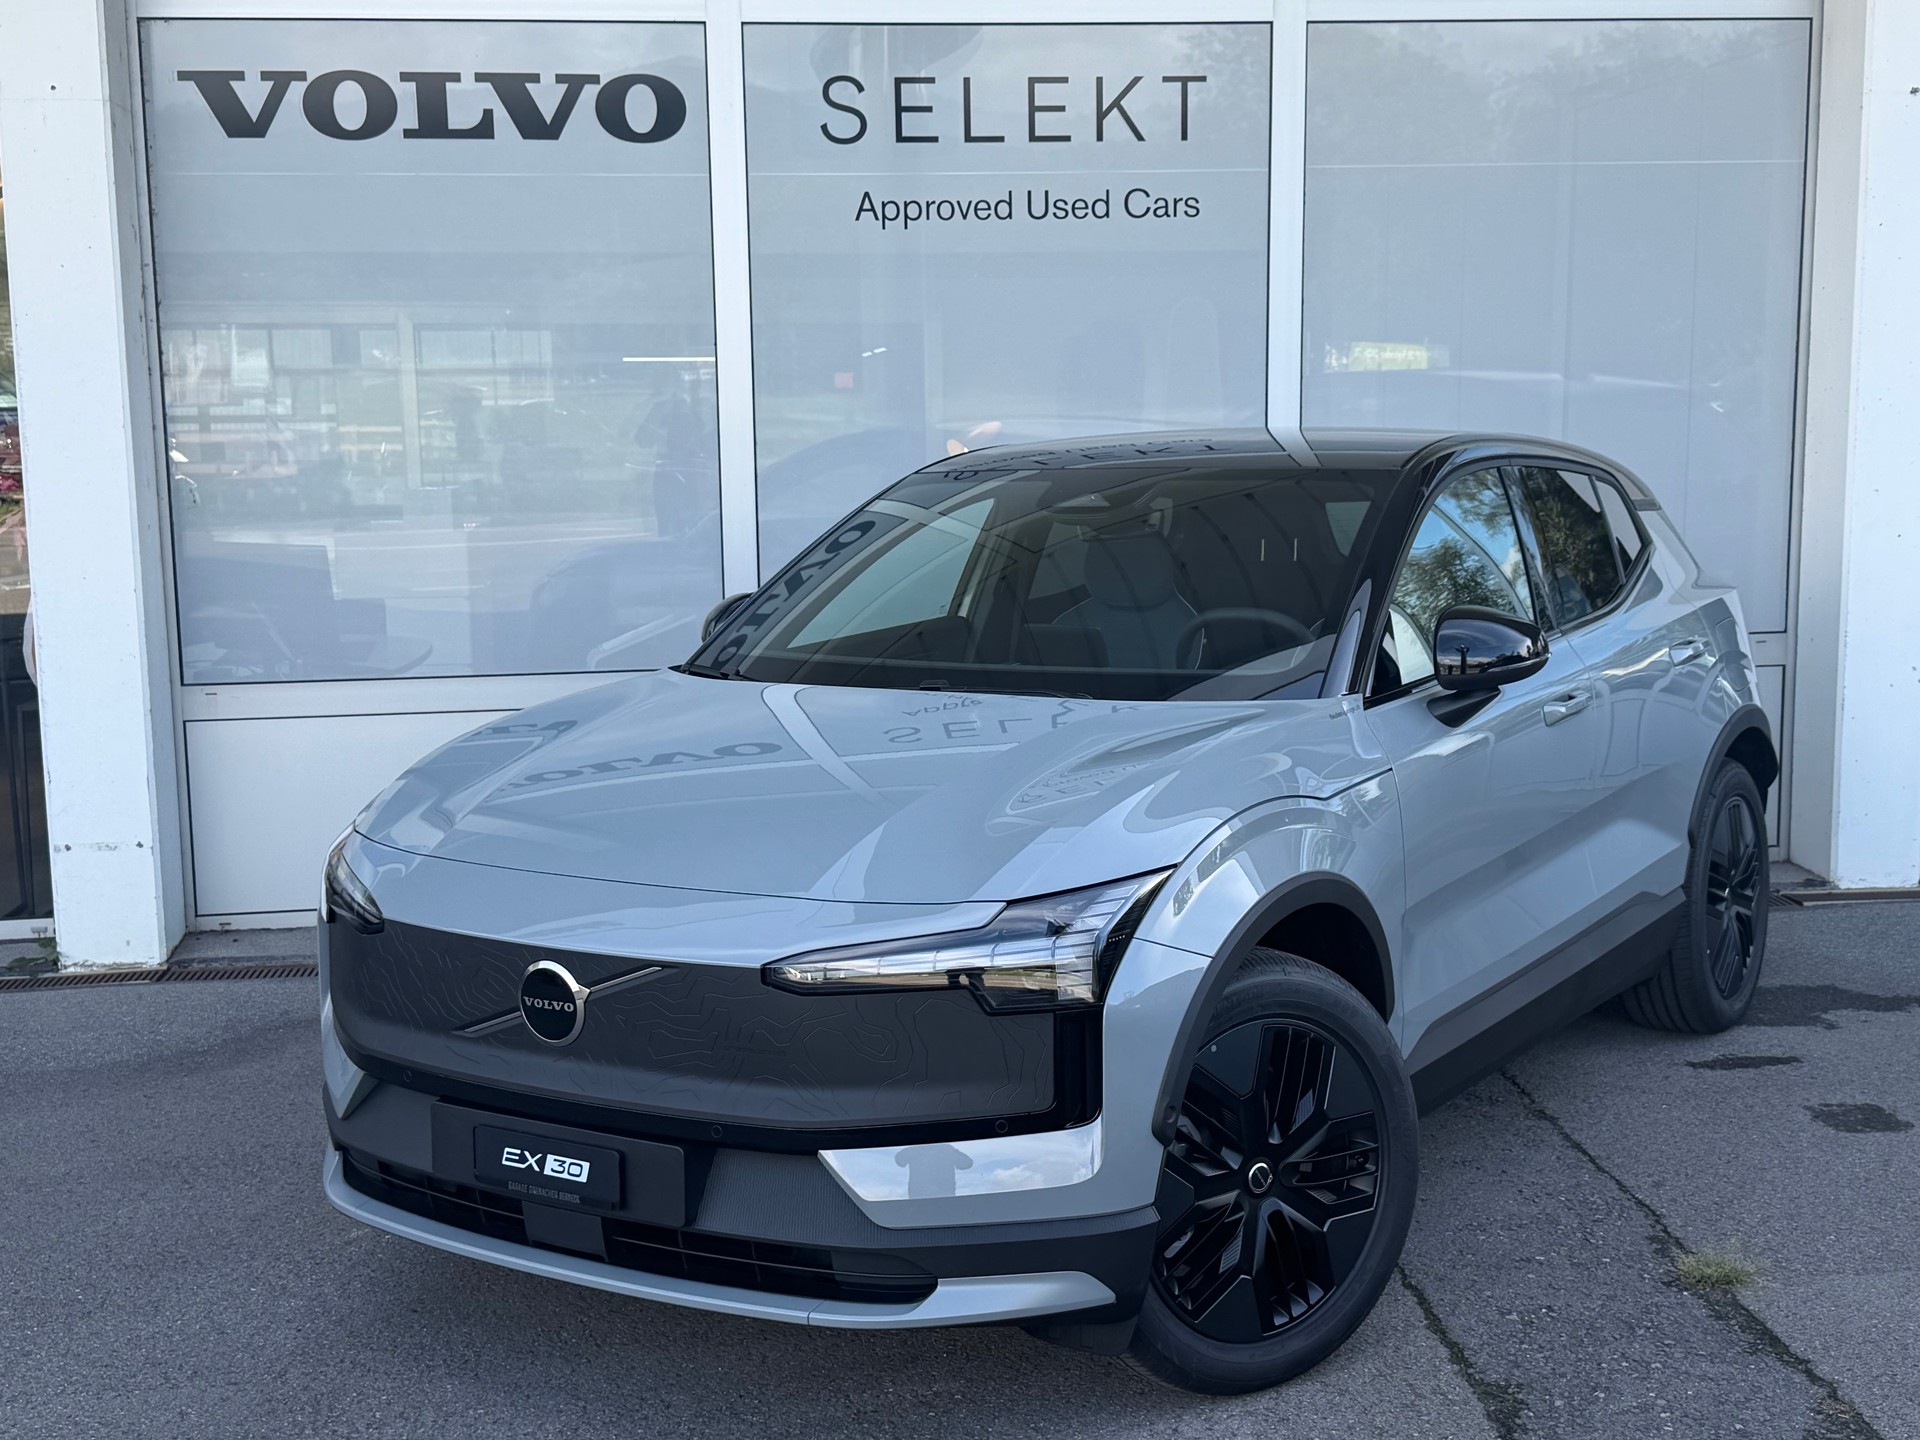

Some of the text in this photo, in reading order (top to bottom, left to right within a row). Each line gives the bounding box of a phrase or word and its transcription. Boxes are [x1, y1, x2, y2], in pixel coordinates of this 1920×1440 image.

[176, 69, 687, 143] VOLVO
[820, 75, 1207, 145] SELEKT
[855, 188, 1200, 230] Approved Used Cars
[523, 996, 574, 1012] VOLVO
